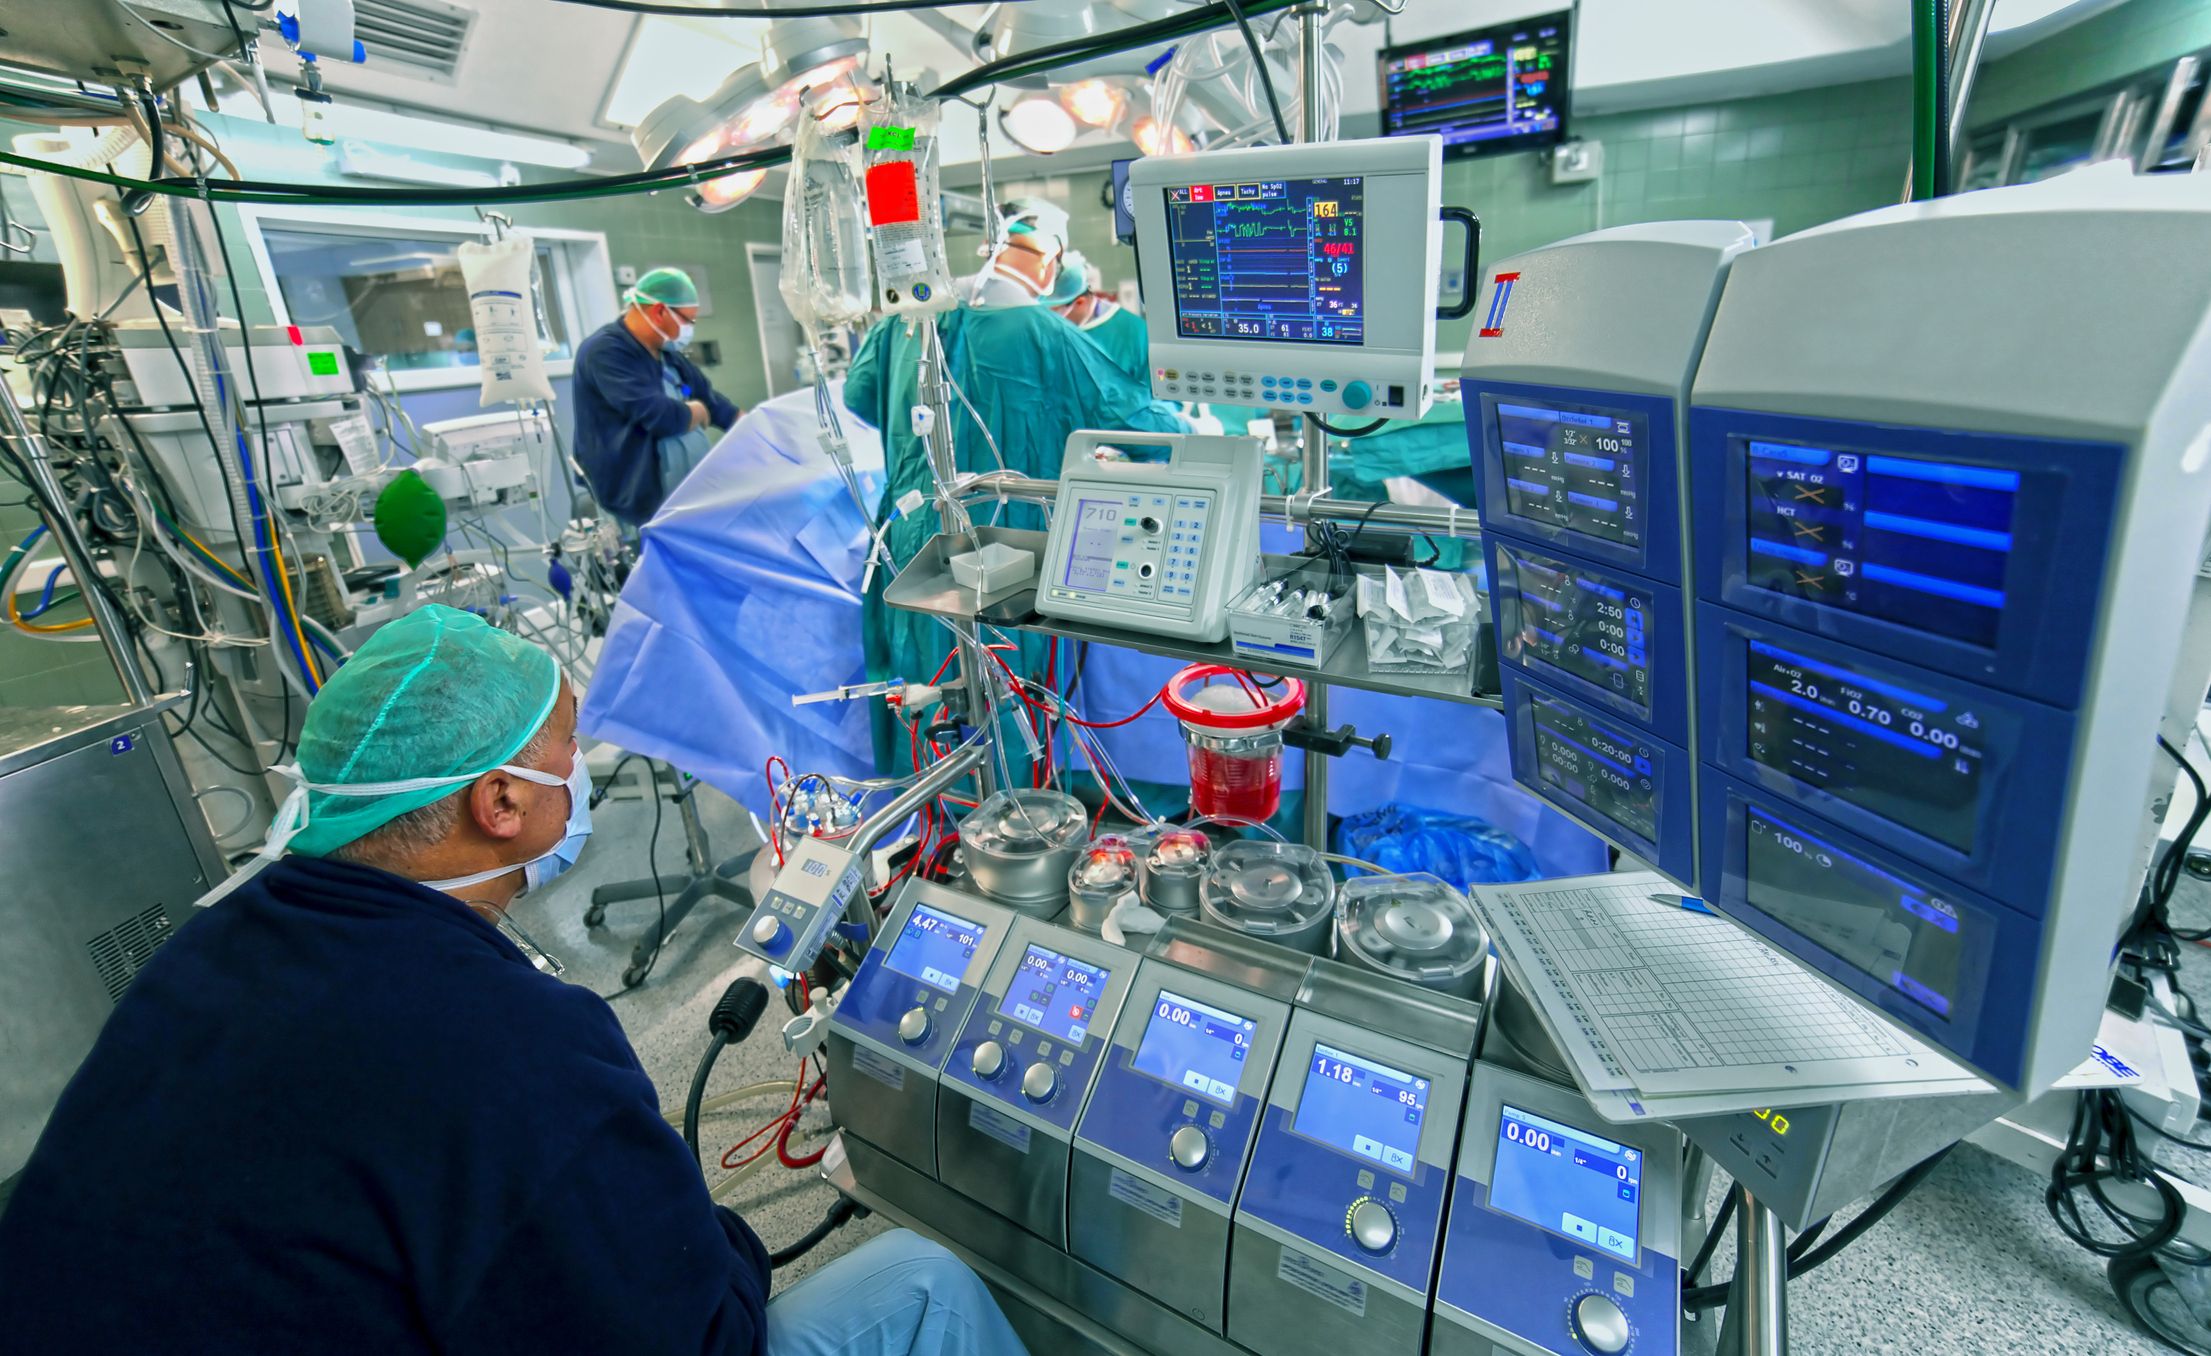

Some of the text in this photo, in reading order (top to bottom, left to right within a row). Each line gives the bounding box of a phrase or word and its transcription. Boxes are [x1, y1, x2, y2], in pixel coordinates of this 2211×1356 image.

[1314, 203, 1338, 217] 164
[1323, 242, 1355, 255] 46/41
[1331, 262, 1348, 274] (5)
[1329, 300, 1338, 309] 36
[1238, 323, 1259, 334] 35.0
[1281, 324, 1289, 332] 61
[1321, 327, 1333, 337] 38
[1596, 437, 1619, 453] 100
[1786, 470, 1806, 482] SAT
[1085, 507, 1118, 521] 710
[1776, 504, 1796, 517] HCT
[1596, 602, 1623, 620] 2:50
[1598, 620, 1624, 639] 0:00
[1599, 638, 1625, 657] 0:00
[1790, 679, 1818, 699] 2.0
[1848, 700, 1891, 725] 0.70
[1909, 721, 1959, 750] 0.00
[116, 740, 126, 750] 2
[1551, 741, 1578, 763] 0.000
[1591, 736, 1632, 765] 0:20:00
[1552, 753, 1579, 775] 00:00
[1600, 768, 1630, 792] 0.000
[1774, 832, 1803, 854] 100
[912, 914, 938, 931] 4.47
[959, 933, 974, 946] 101
[1027, 955, 1047, 970] 0.00
[1066, 969, 1088, 985] 0.00
[1158, 1002, 1191, 1026] 0.00
[1233, 1033, 1243, 1045] 0
[1317, 1057, 1353, 1084] 1.18
[1398, 1090, 1416, 1106] 95
[1506, 1121, 1550, 1152] 0.00
[1616, 1165, 1627, 1180] 0
